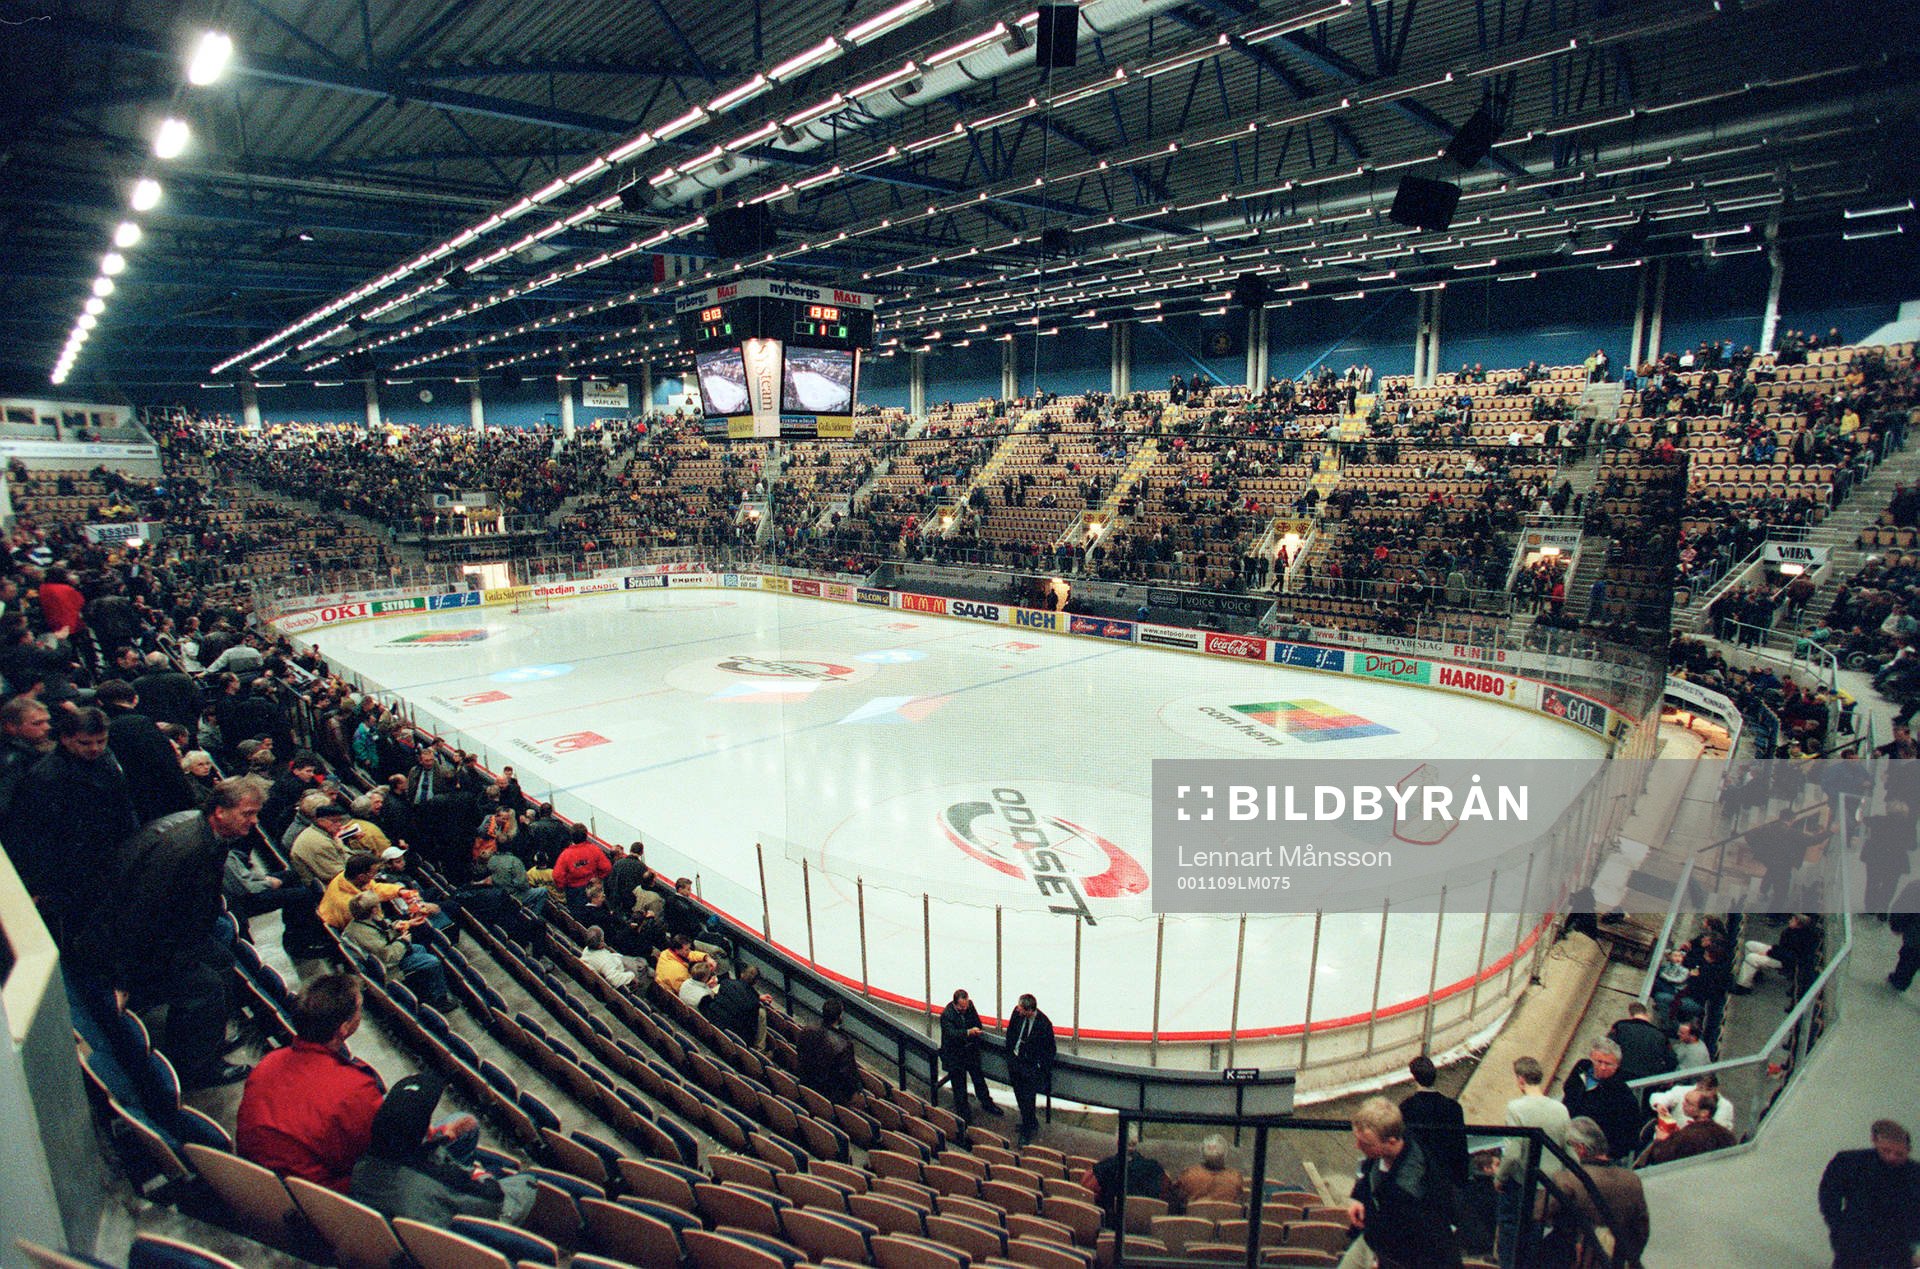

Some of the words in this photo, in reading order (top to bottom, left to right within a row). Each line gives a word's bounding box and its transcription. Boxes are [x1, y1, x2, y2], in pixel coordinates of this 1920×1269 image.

[717, 285, 738, 299] MAXI
[769, 282, 820, 300] nybergs
[833, 289, 861, 305] MAXI
[321, 603, 367, 622] OKI
[952, 601, 999, 620] SAAB
[1143, 627, 1197, 639] www.netpool.net
[1439, 667, 1505, 696] HARIBO
[991, 787, 1098, 926] ODDSET
